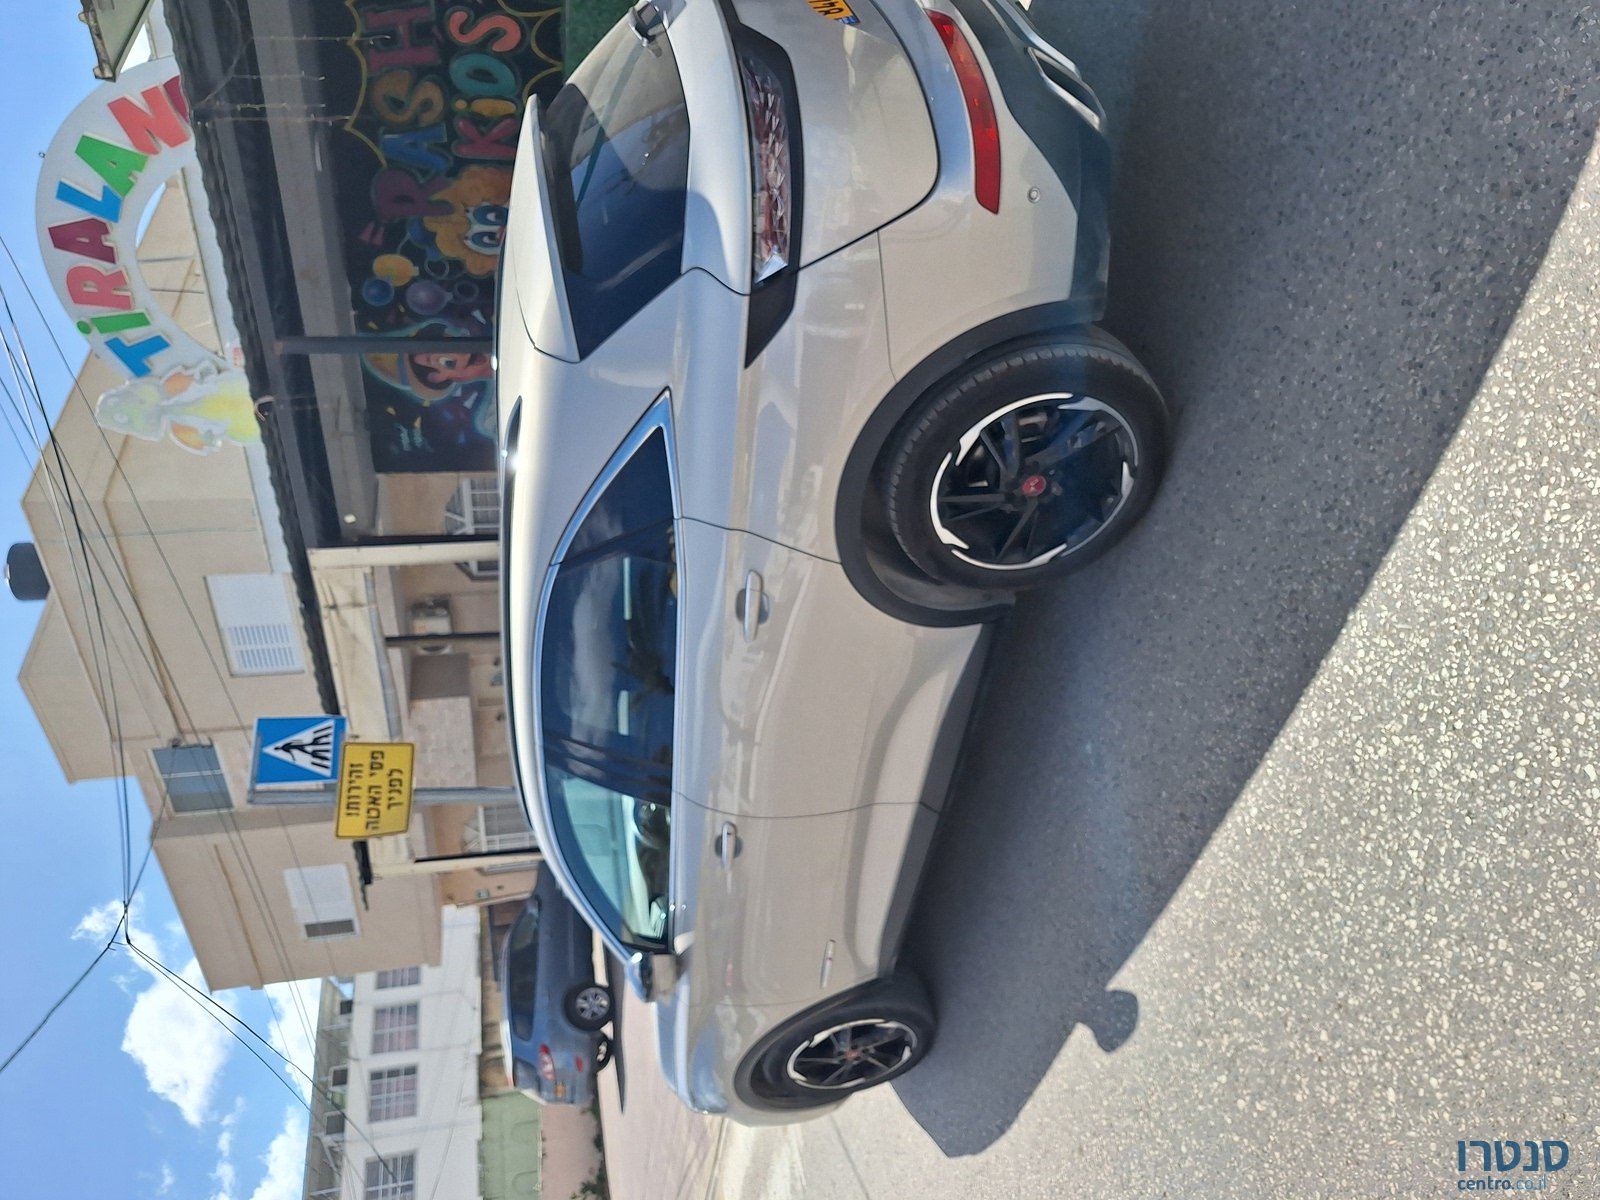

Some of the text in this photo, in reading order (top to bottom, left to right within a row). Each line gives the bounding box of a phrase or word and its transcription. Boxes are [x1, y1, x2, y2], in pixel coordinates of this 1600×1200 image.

[366, 4, 454, 220] RASH
[344, 762, 364, 817] זהירות!
[365, 750, 385, 831] פסי האטה
[385, 768, 403, 811] לפניך
